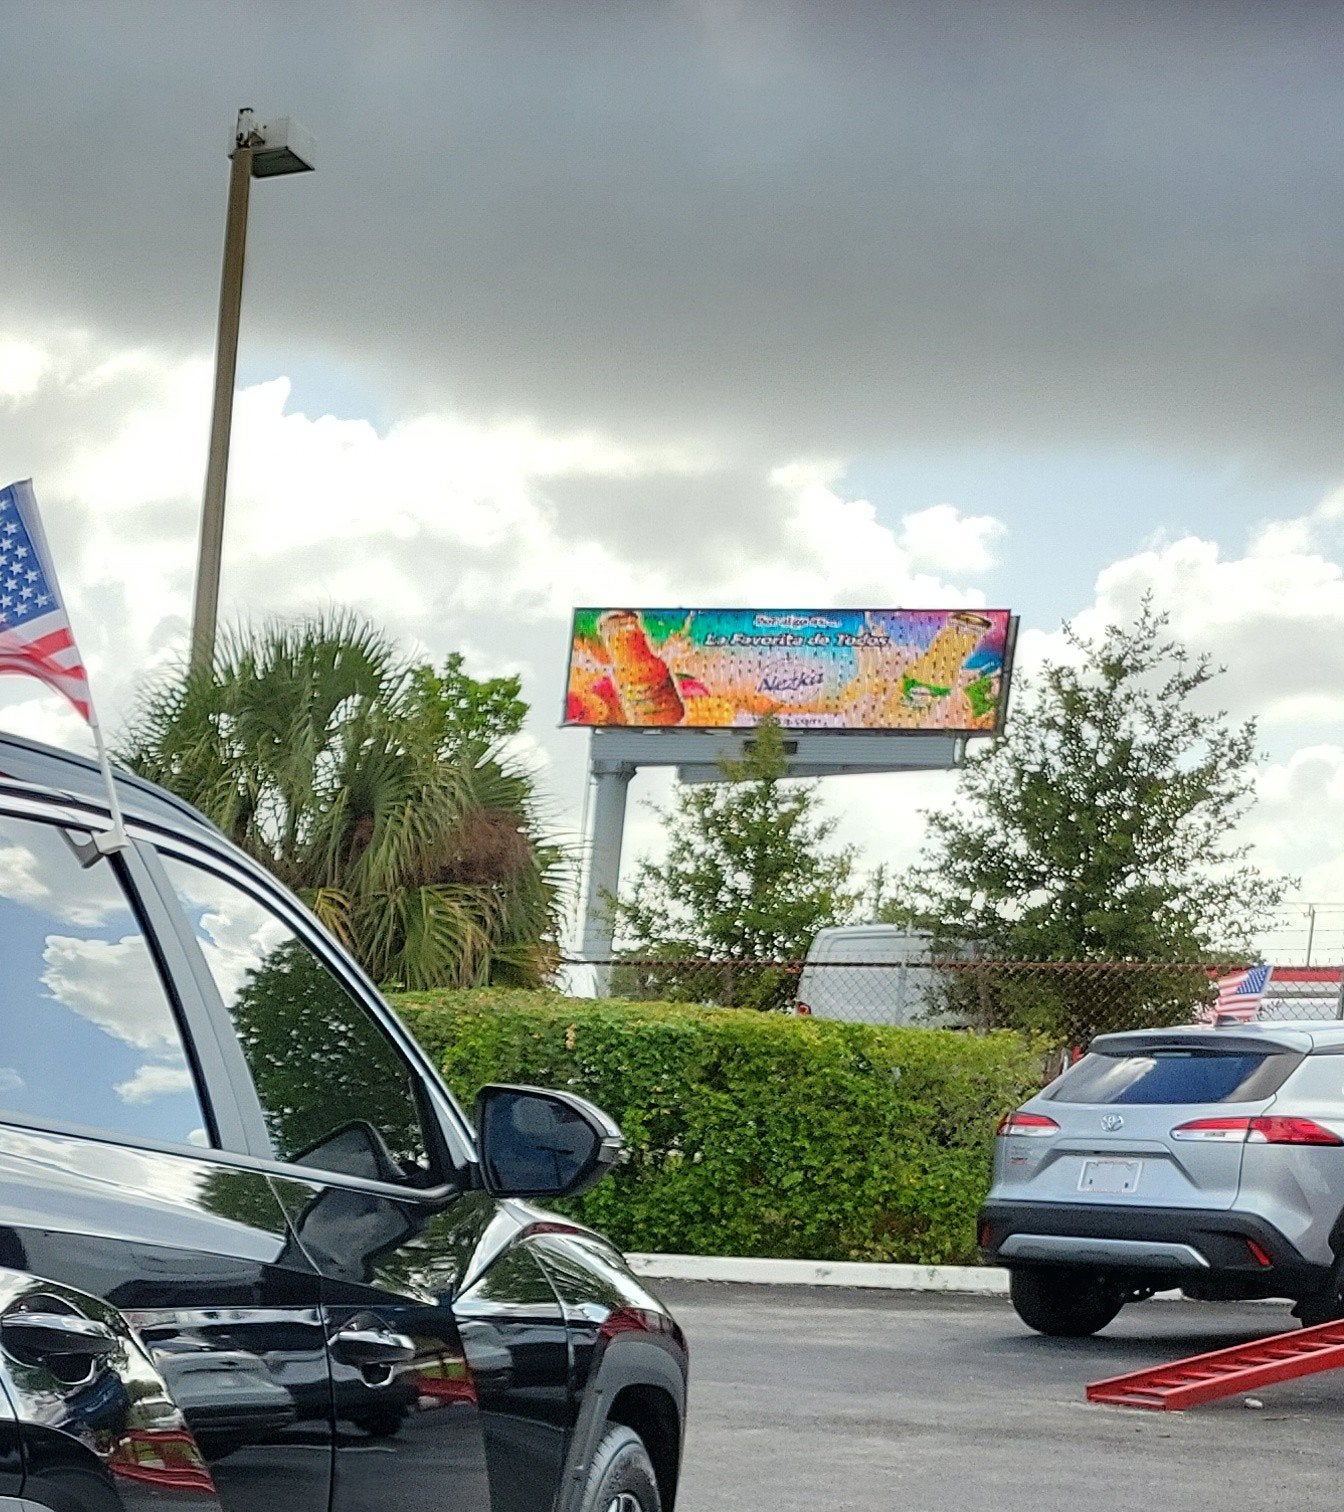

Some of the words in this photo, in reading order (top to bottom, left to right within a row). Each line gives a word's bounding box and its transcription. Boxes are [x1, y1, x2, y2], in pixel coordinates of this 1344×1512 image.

[705, 633, 726, 646] La
[729, 633, 804, 647] Favorita
[807, 633, 831, 647] de
[837, 634, 891, 648] Todos
